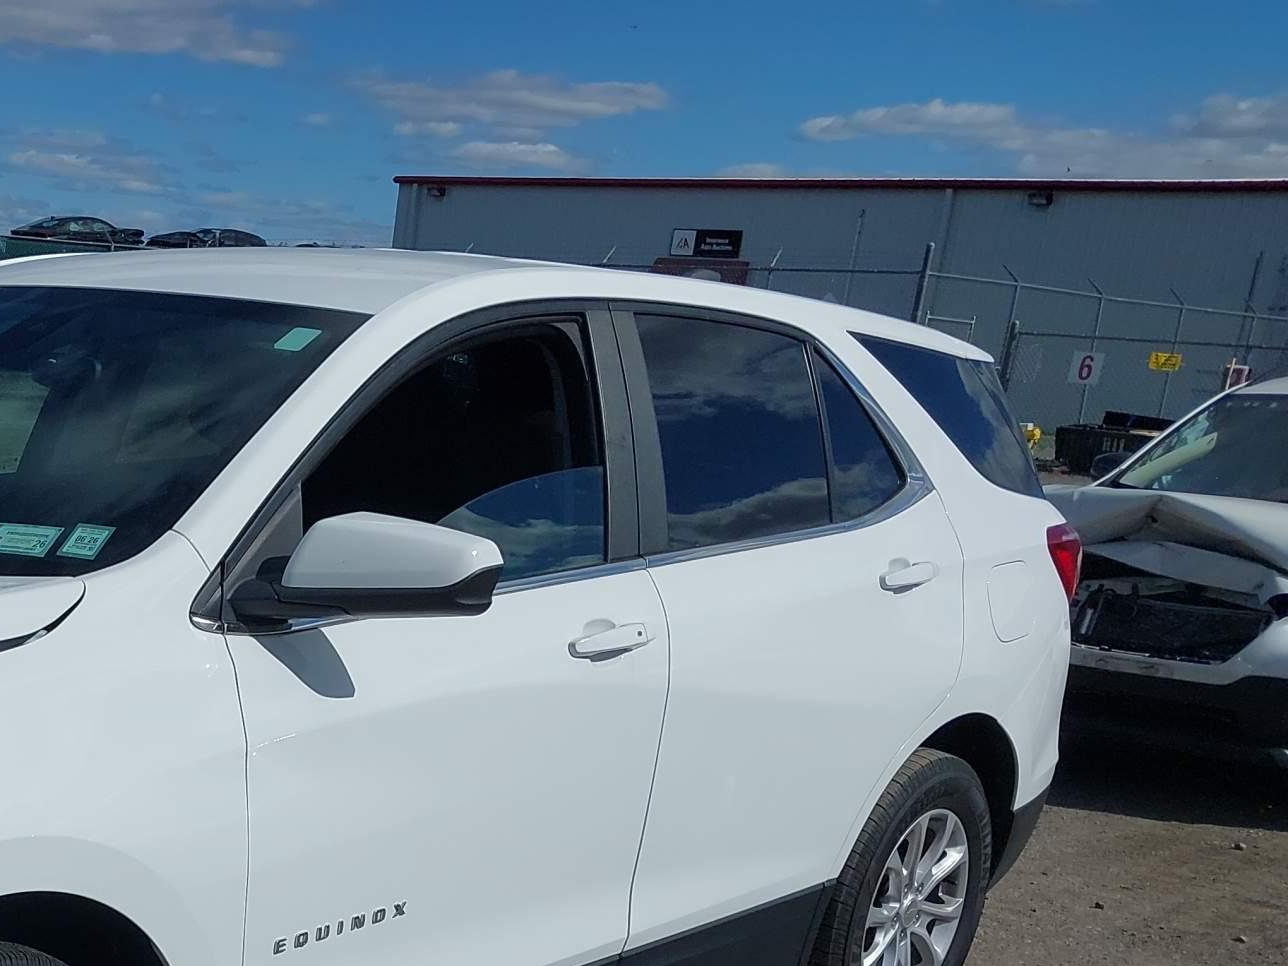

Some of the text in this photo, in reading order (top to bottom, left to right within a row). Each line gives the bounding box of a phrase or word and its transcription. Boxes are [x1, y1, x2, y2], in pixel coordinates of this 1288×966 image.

[1078, 355, 1094, 381] 6
[32, 540, 49, 549] 26
[273, 901, 407, 955] EQUINOX
